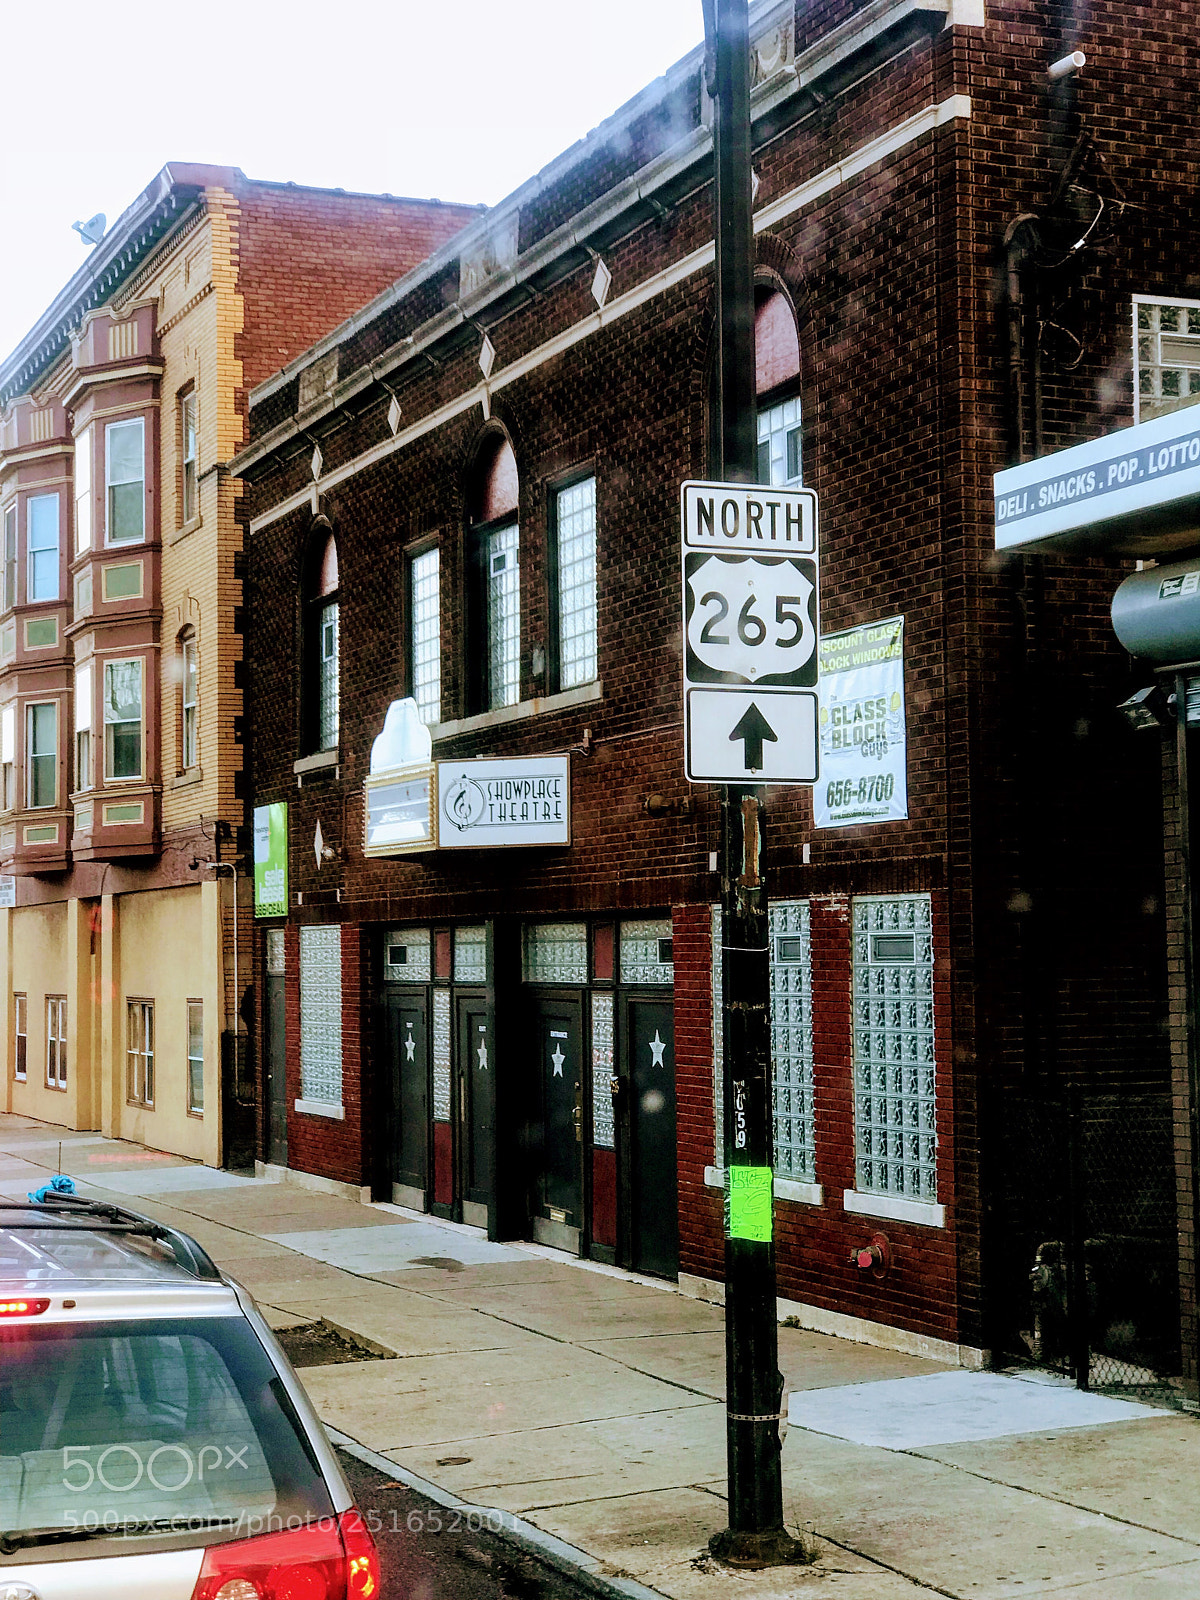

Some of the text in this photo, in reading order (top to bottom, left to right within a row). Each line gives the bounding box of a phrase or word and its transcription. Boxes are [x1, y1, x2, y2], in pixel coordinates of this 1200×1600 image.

[997, 495, 1028, 521] DELI
[1038, 470, 1096, 508] SNACKS
[1148, 437, 1200, 474] LOTTO
[696, 497, 804, 542] NORTH
[699, 591, 804, 649] 265
[819, 623, 901, 655] ISCOUNT GLASS
[852, 642, 902, 666] WINDOWS
[831, 698, 887, 727] GLASS
[831, 721, 887, 750] BLOCK
[861, 740, 889, 761] Guys
[487, 779, 561, 801] SHOWPLACE
[827, 772, 895, 808] 656-8700
[488, 801, 562, 822] THEATRE
